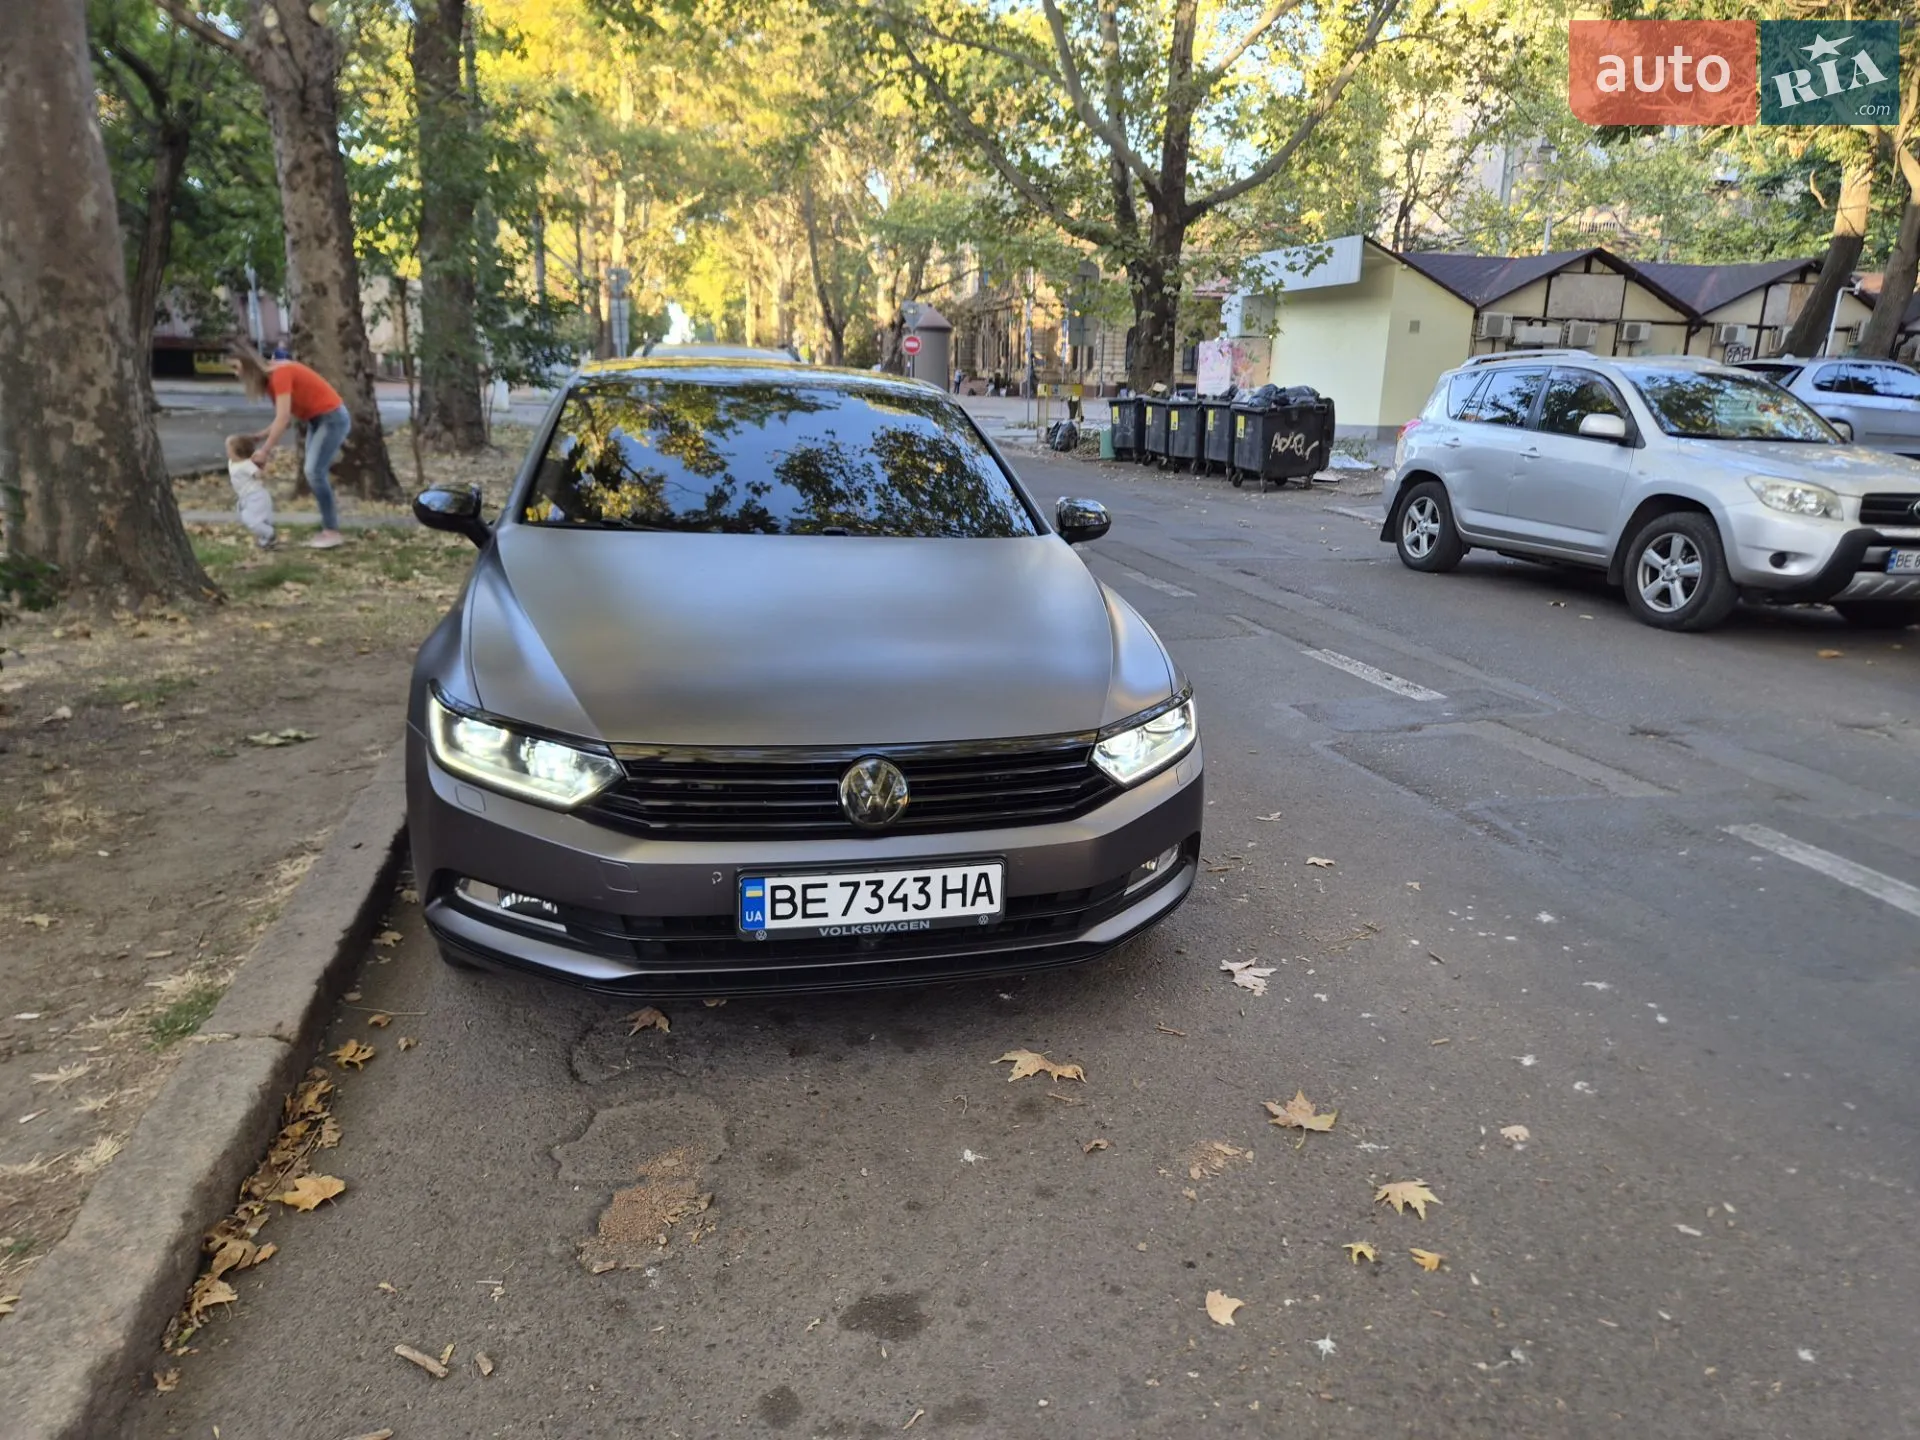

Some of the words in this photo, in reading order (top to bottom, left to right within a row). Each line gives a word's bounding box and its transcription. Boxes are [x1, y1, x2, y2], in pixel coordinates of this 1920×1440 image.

[769, 882, 829, 921] BE
[838, 875, 932, 918] 7343
[941, 872, 995, 909] HA
[745, 910, 763, 922] UA
[818, 919, 930, 937] VOLKSWAGEN
